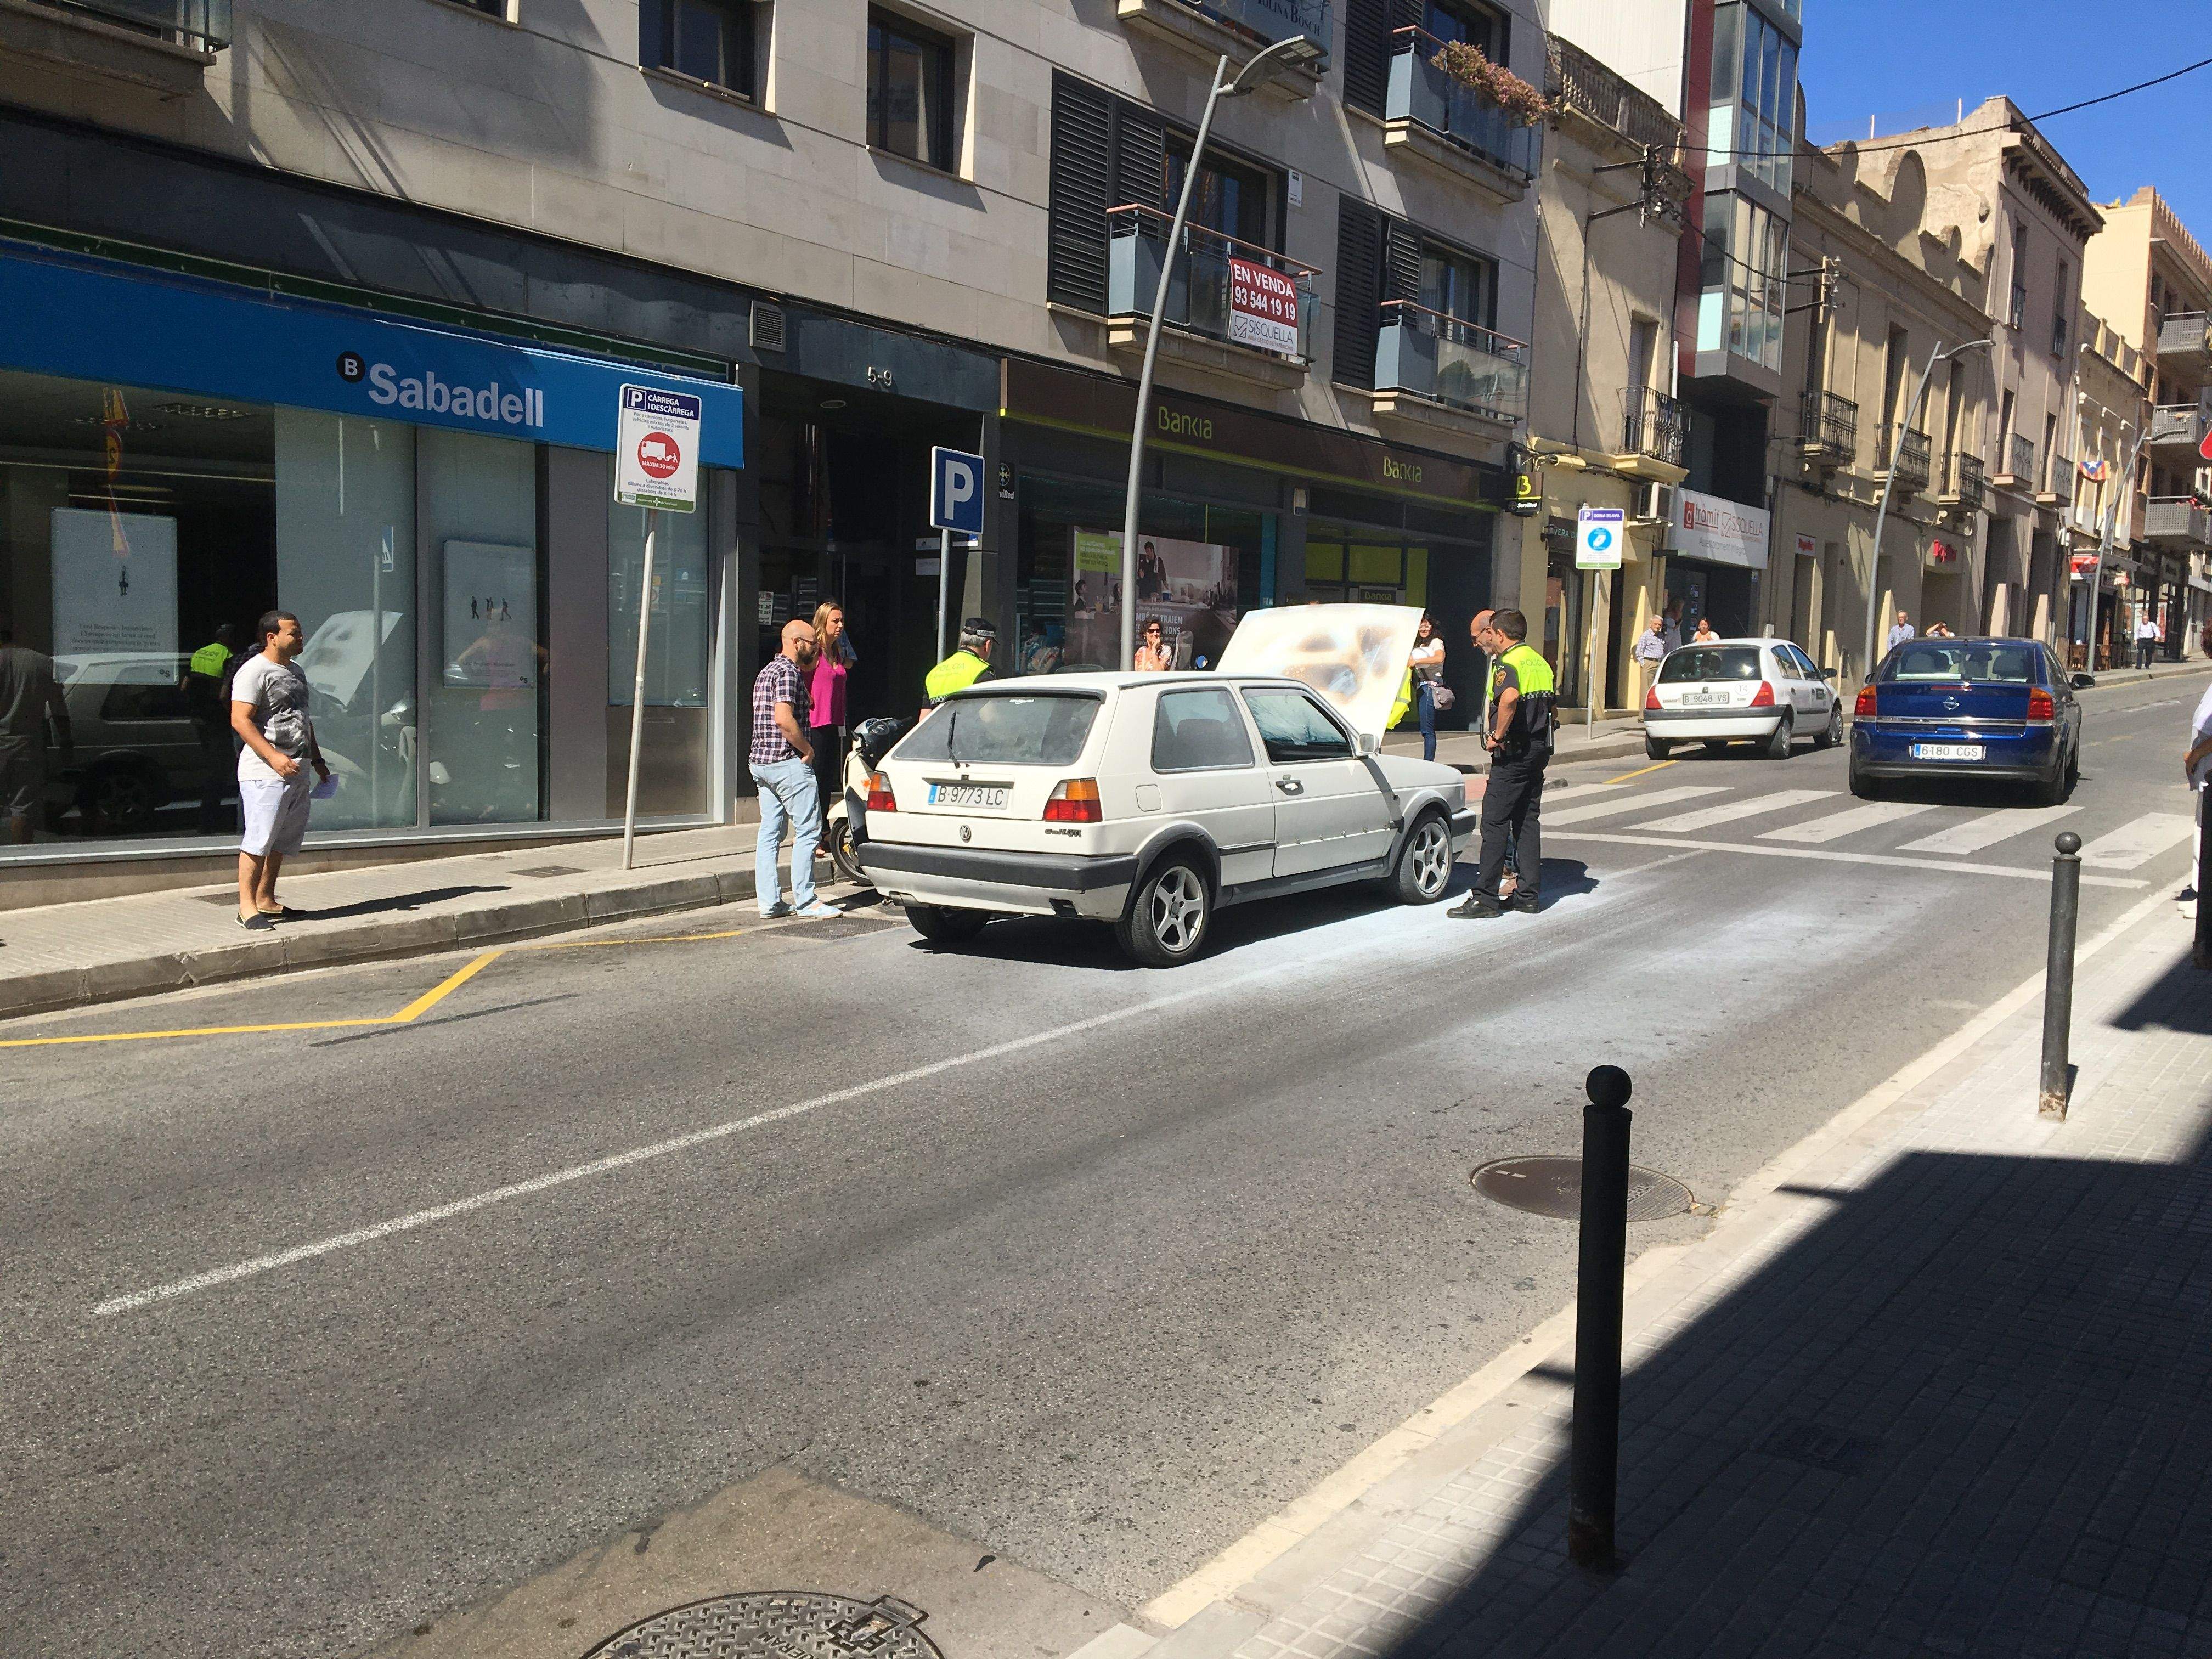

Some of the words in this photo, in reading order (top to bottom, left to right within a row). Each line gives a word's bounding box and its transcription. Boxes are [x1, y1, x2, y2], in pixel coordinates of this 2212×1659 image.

[1233, 263, 1251, 284] EN
[1252, 270, 1295, 299] VENDA
[1235, 285, 1248, 306] 93
[1250, 290, 1268, 312] 544
[1271, 297, 1282, 317] 19
[1284, 302, 1296, 320] 19
[1249, 319, 1293, 345] SISQUELLA
[345, 358, 358, 376] B
[868, 366, 893, 386] 5-9
[368, 363, 544, 427] Sabadell
[631, 391, 643, 407] P
[648, 393, 680, 407] CÀRREGA
[651, 403, 695, 417] DESCÀRREGA
[1158, 405, 1212, 439] Bankia
[1383, 456, 1422, 483] Bankia
[944, 459, 974, 520] P
[1000, 489, 1014, 500] viRed
[1583, 511, 1591, 520] P
[1365, 591, 1392, 601] Bankia
[1160, 614, 1183, 624] TRAIEM
[1693, 695, 1713, 703] 9048
[1718, 694, 1727, 702] VS
[1922, 746, 1950, 755] 6180
[1956, 747, 1978, 757] CGS
[986, 788, 1004, 805] LC
